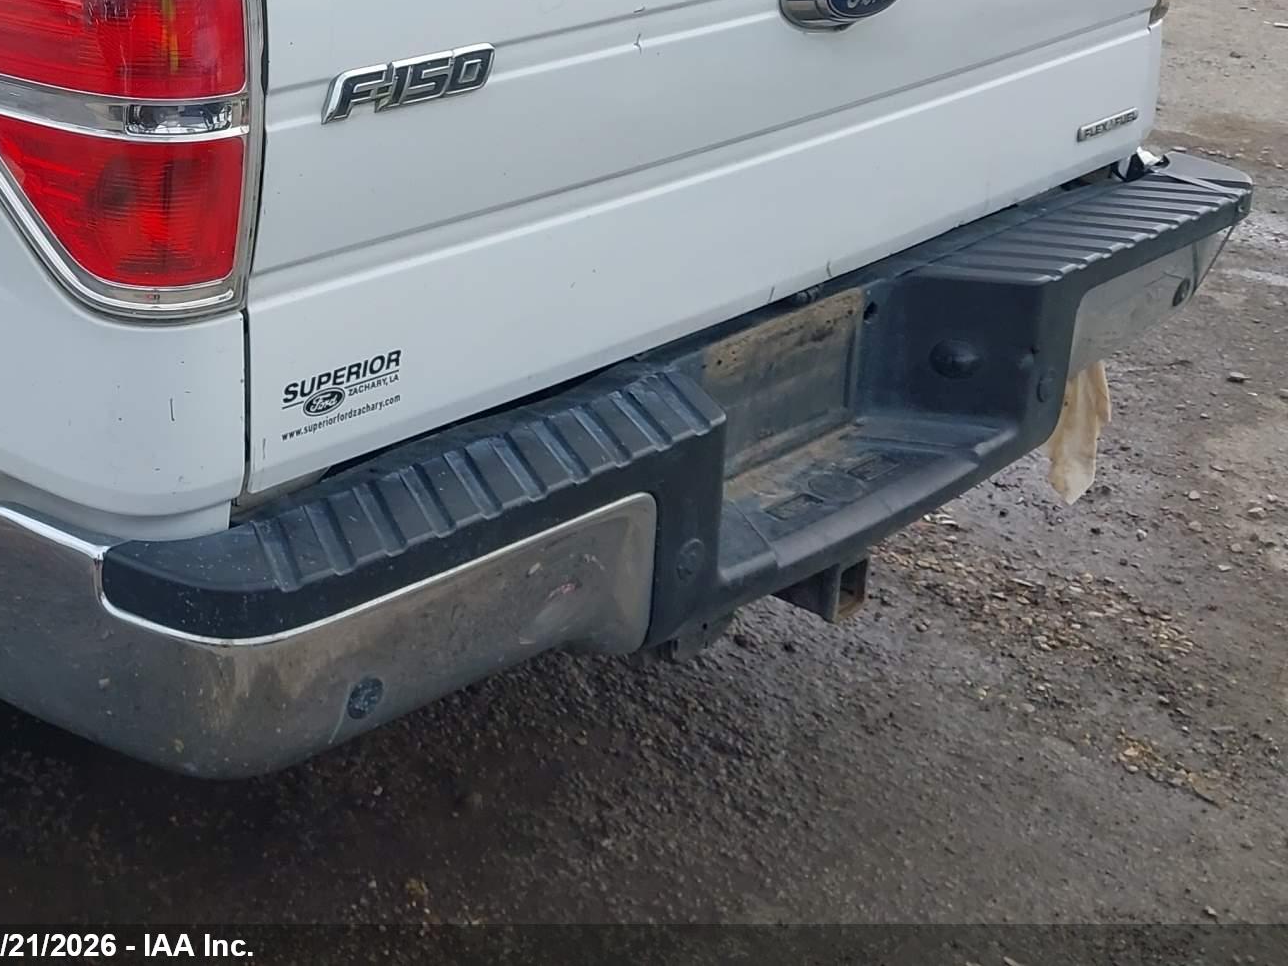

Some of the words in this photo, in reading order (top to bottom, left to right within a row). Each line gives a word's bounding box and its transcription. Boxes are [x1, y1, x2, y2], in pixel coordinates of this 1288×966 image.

[321, 42, 496, 126] F-150
[282, 349, 402, 404] SUPERIOR
[347, 377, 389, 397] ZACHARY,
[389, 374, 400, 383] LA
[281, 394, 401, 441] www.superiorfordzachary.com
[309, 392, 340, 412] Ford
